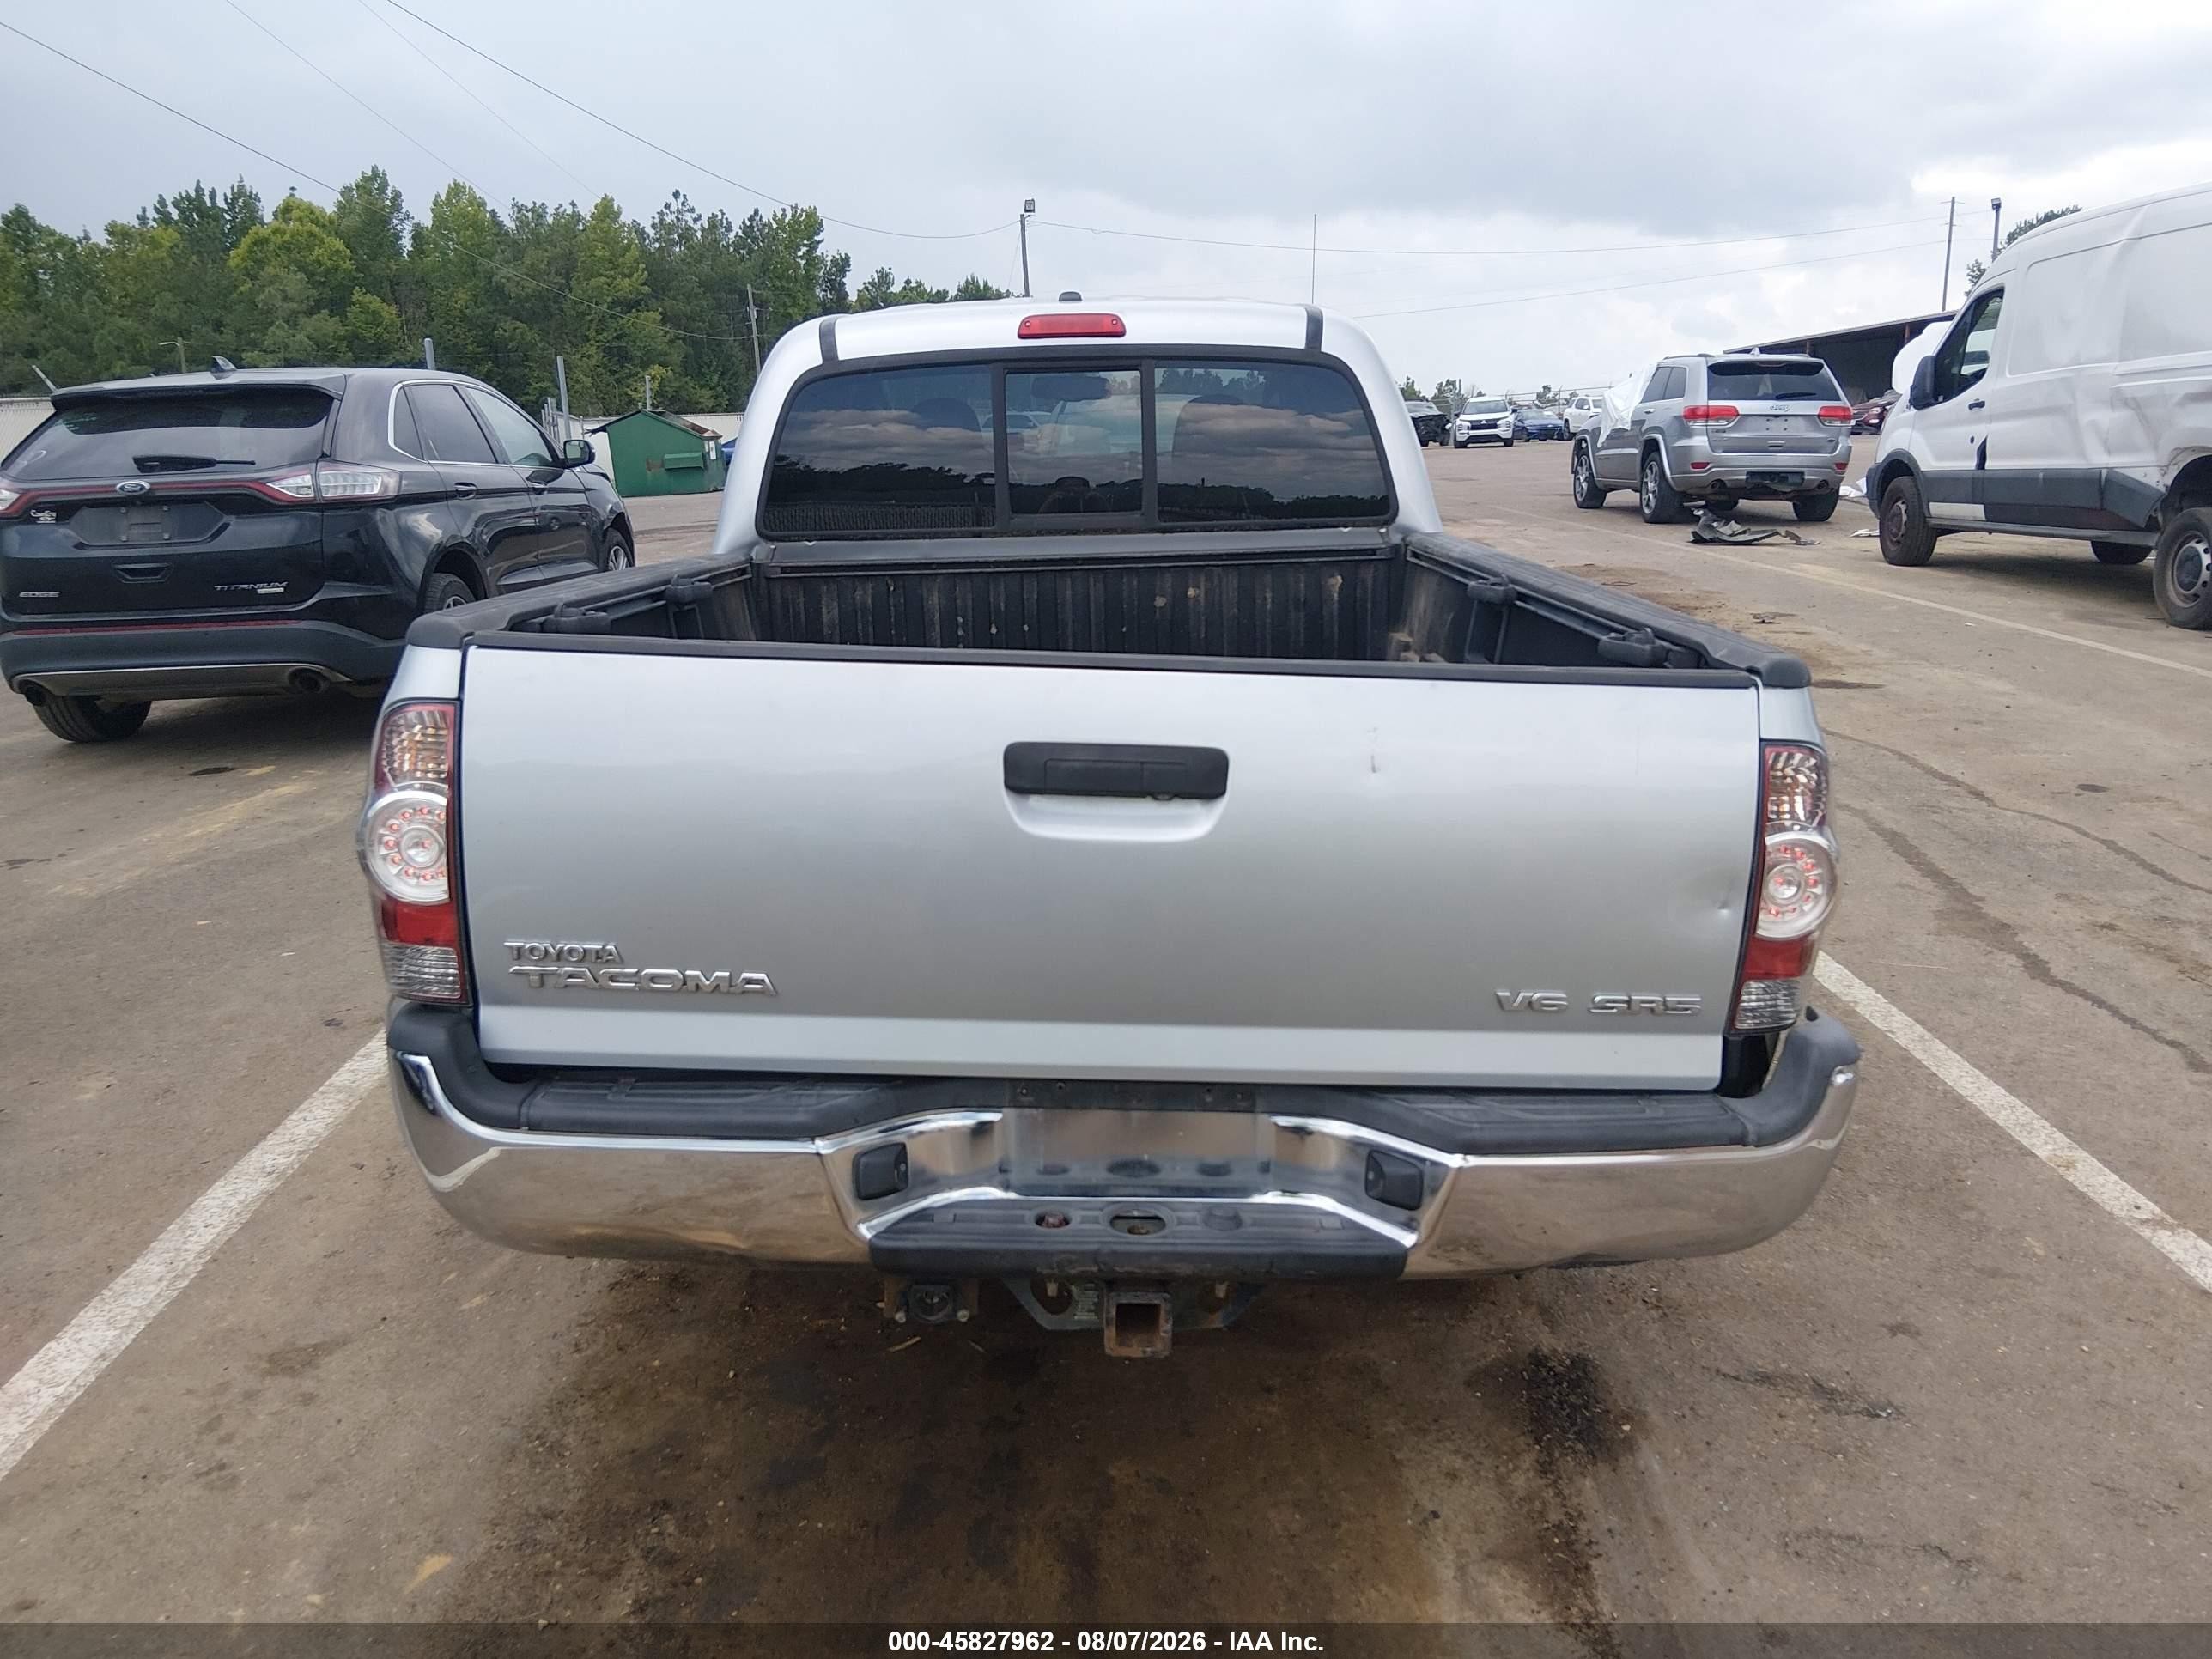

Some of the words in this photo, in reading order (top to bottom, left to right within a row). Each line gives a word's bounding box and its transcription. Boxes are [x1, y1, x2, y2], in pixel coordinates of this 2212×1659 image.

[503, 941, 623, 963] TOYOTA
[508, 965, 778, 996] TACOMA
[1495, 990, 1569, 1012] V6
[1589, 994, 1703, 1016] SR5
